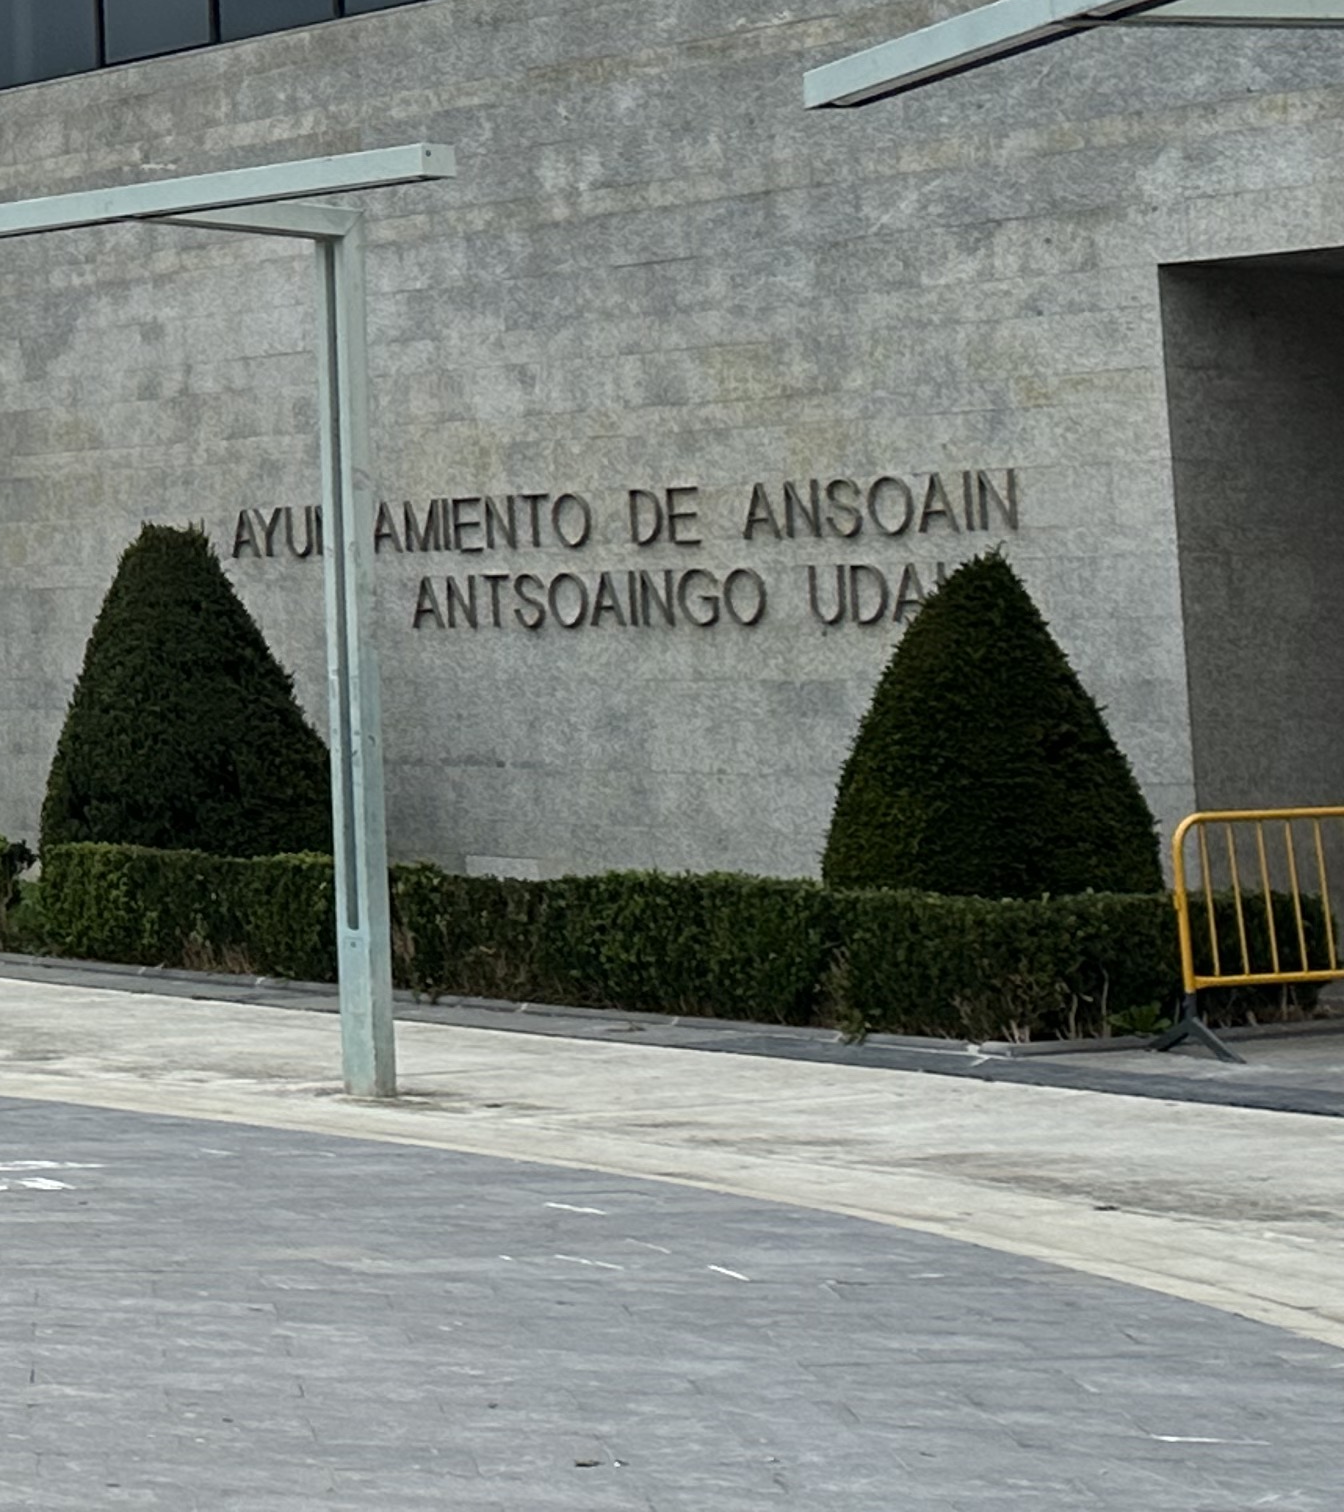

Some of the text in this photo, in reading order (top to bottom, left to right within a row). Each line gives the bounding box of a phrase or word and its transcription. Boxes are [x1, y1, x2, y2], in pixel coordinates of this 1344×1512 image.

[232, 467, 1019, 558] AYUAMIENTO DE ANSOAIN
[412, 567, 767, 630] ANTSOAINGO
